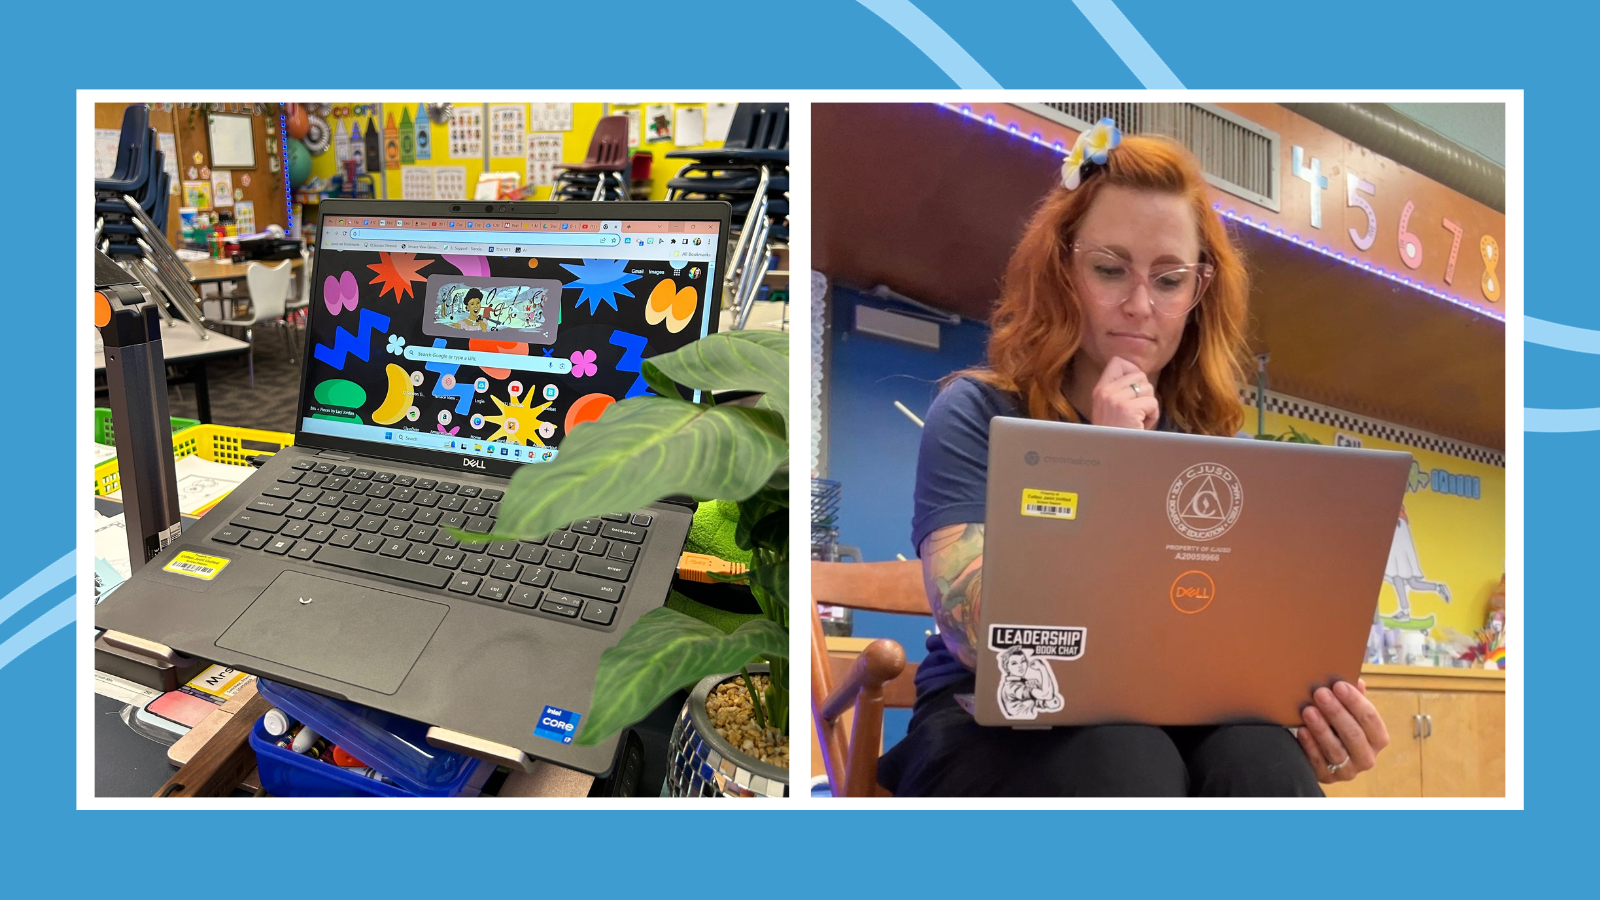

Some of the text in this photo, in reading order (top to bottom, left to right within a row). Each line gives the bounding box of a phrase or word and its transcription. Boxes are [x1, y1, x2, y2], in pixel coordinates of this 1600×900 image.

[1291, 145, 1328, 230] 4
[1346, 172, 1377, 251] 5
[1398, 200, 1423, 270] 6
[1442, 217, 1464, 286] 7
[1479, 234, 1500, 303] 8
[463, 458, 486, 469] DELL
[1186, 465, 1232, 481] CJUSD
[1169, 500, 1180, 524] BOARD
[1186, 525, 1225, 538] EDUCATION
[1176, 586, 1209, 599] DELL
[996, 629, 1080, 646] LEADERSHIP
[1036, 646, 1078, 655] BOOK CHAT
[206, 667, 234, 686] Mrs
[547, 708, 562, 716] intel
